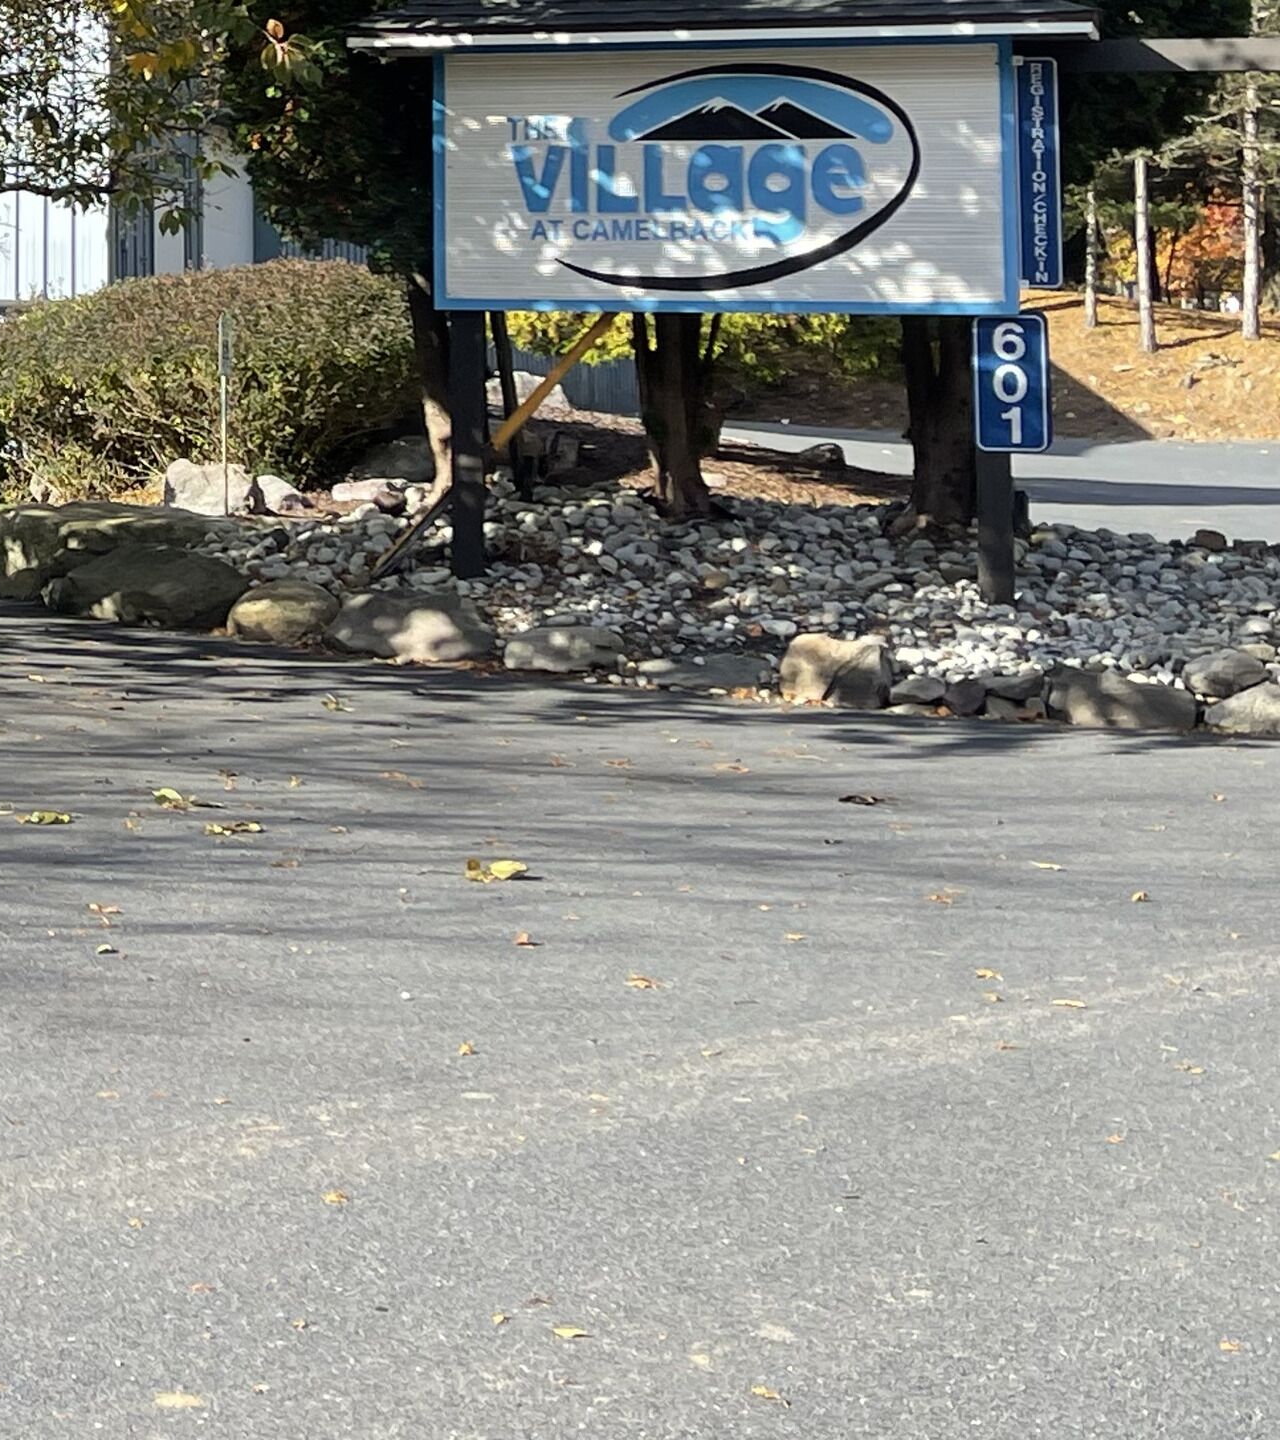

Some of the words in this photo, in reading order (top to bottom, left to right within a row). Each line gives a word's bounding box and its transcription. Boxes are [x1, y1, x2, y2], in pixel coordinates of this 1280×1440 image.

[531, 219, 564, 241] AT
[573, 219, 749, 241] CAMELBACK
[992, 322, 1028, 444] 601
